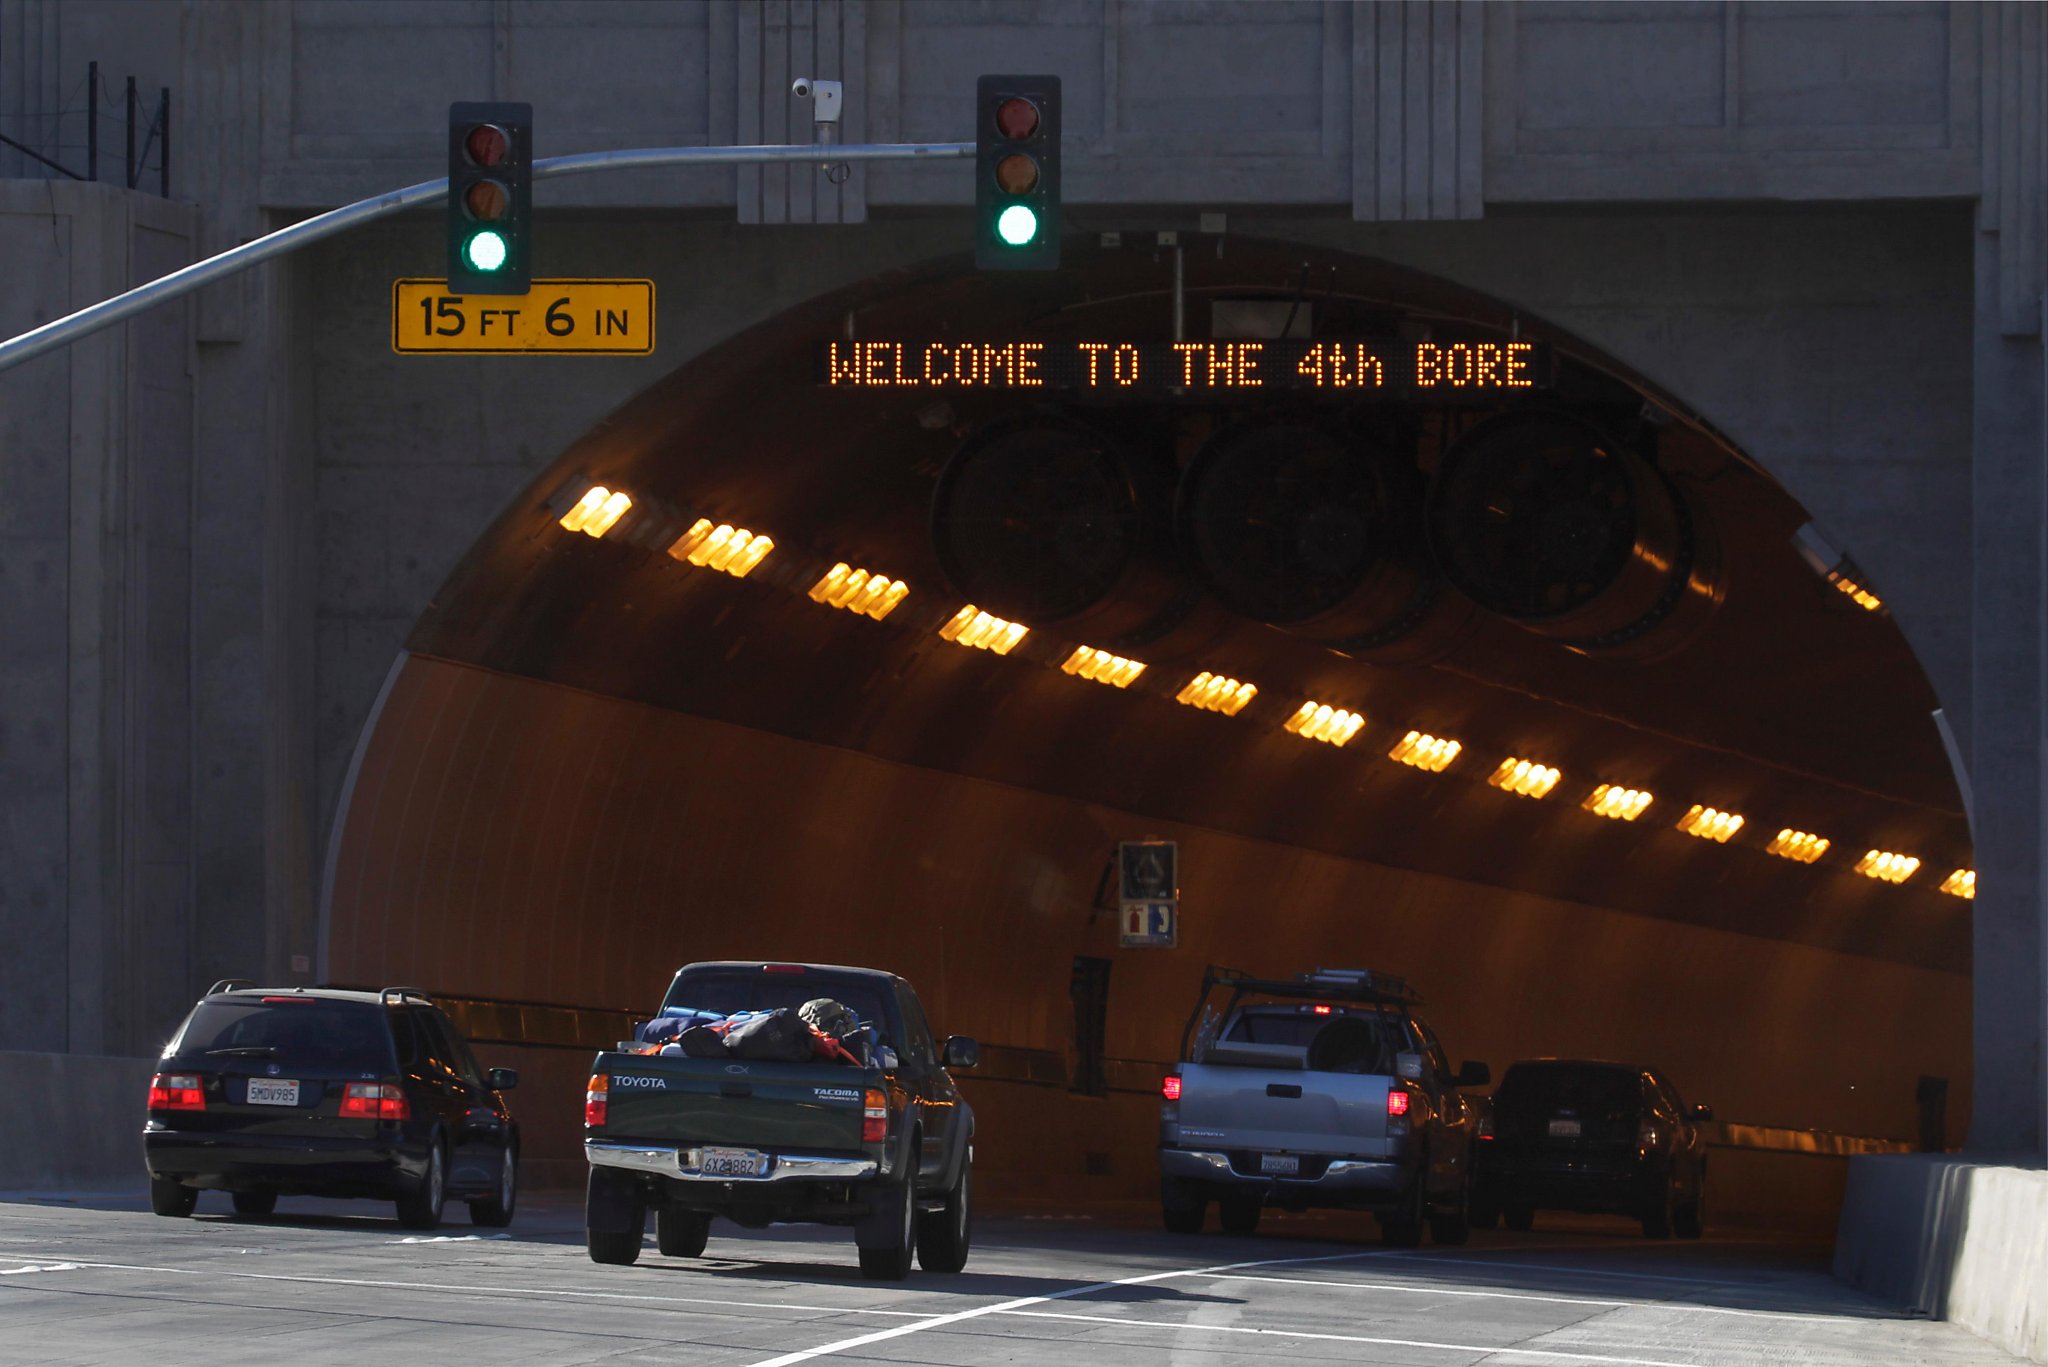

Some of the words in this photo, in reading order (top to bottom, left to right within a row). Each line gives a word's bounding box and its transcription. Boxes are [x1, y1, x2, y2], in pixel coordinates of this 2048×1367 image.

[420, 296, 466, 337] 15
[480, 309, 521, 336] FT
[545, 297, 575, 337] 6
[595, 309, 628, 336] IN
[829, 342, 1045, 386] WELCOME
[1079, 342, 1139, 386] TO
[1173, 342, 1263, 386] THE
[1297, 342, 1383, 386] 4th
[1416, 342, 1533, 386] BORE
[613, 1075, 666, 1089] TOYOTA
[250, 1087, 295, 1102] 5MDV985
[813, 1088, 859, 1097] TACOMA
